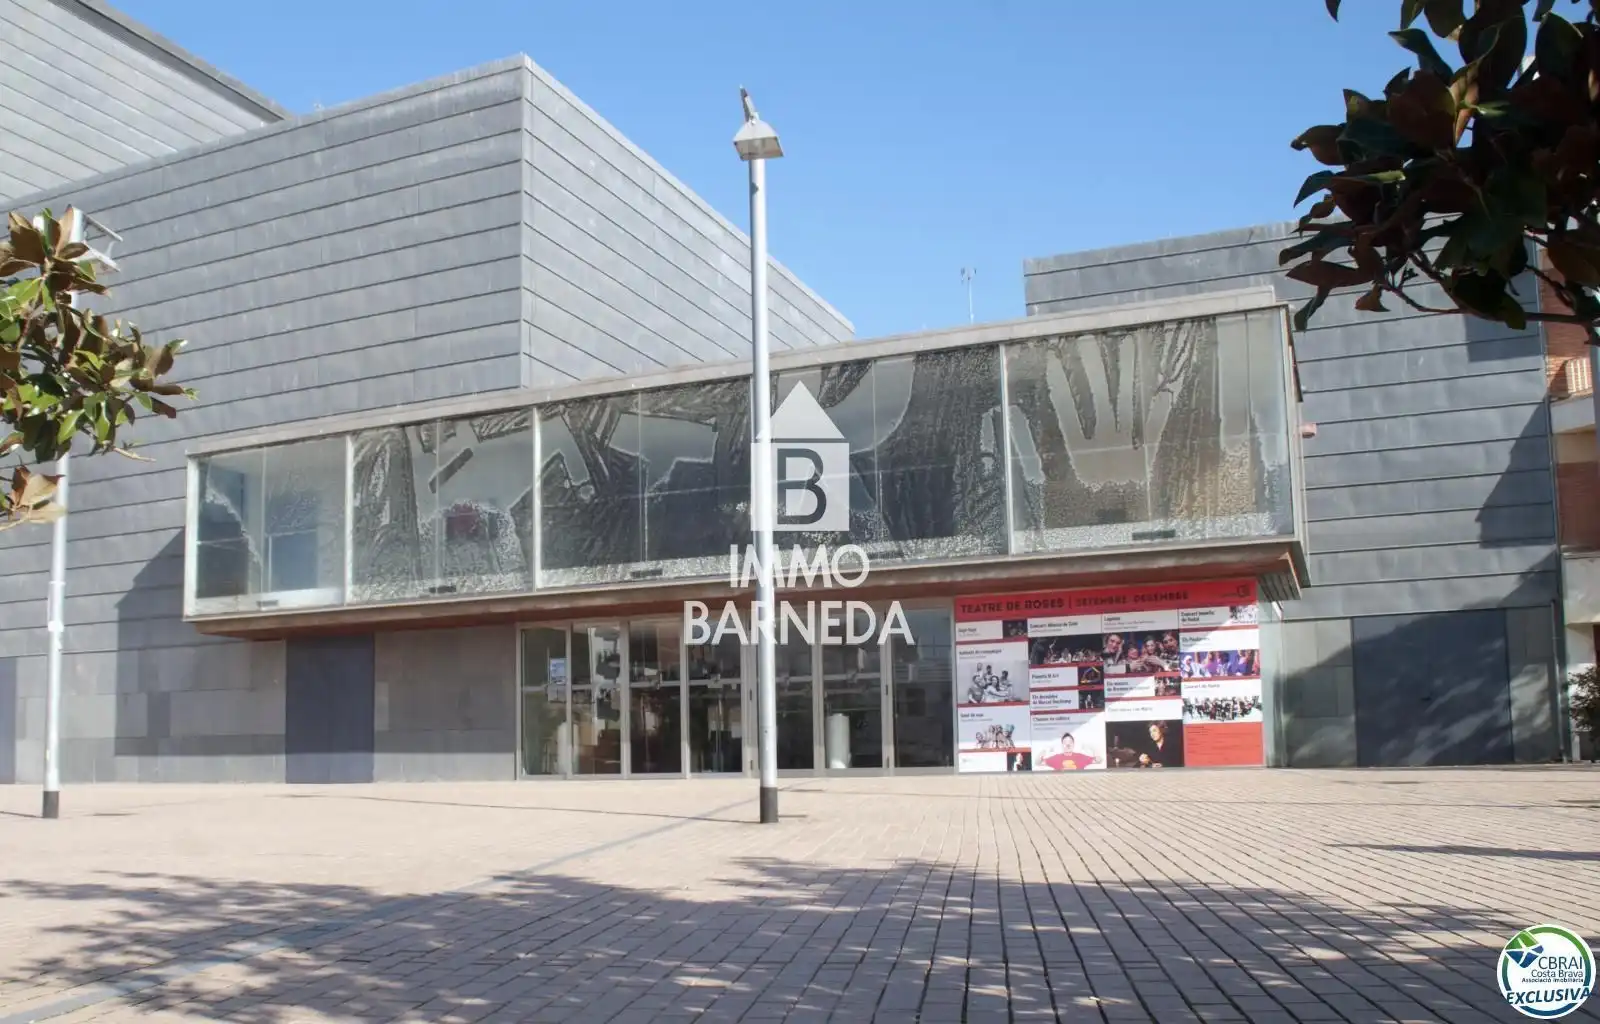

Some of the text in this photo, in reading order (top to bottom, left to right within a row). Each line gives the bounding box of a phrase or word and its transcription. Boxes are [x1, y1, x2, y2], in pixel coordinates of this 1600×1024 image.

[961, 602, 1003, 614] TEATRE
[1006, 600, 1021, 611] DE
[1024, 597, 1065, 610] ROSES
